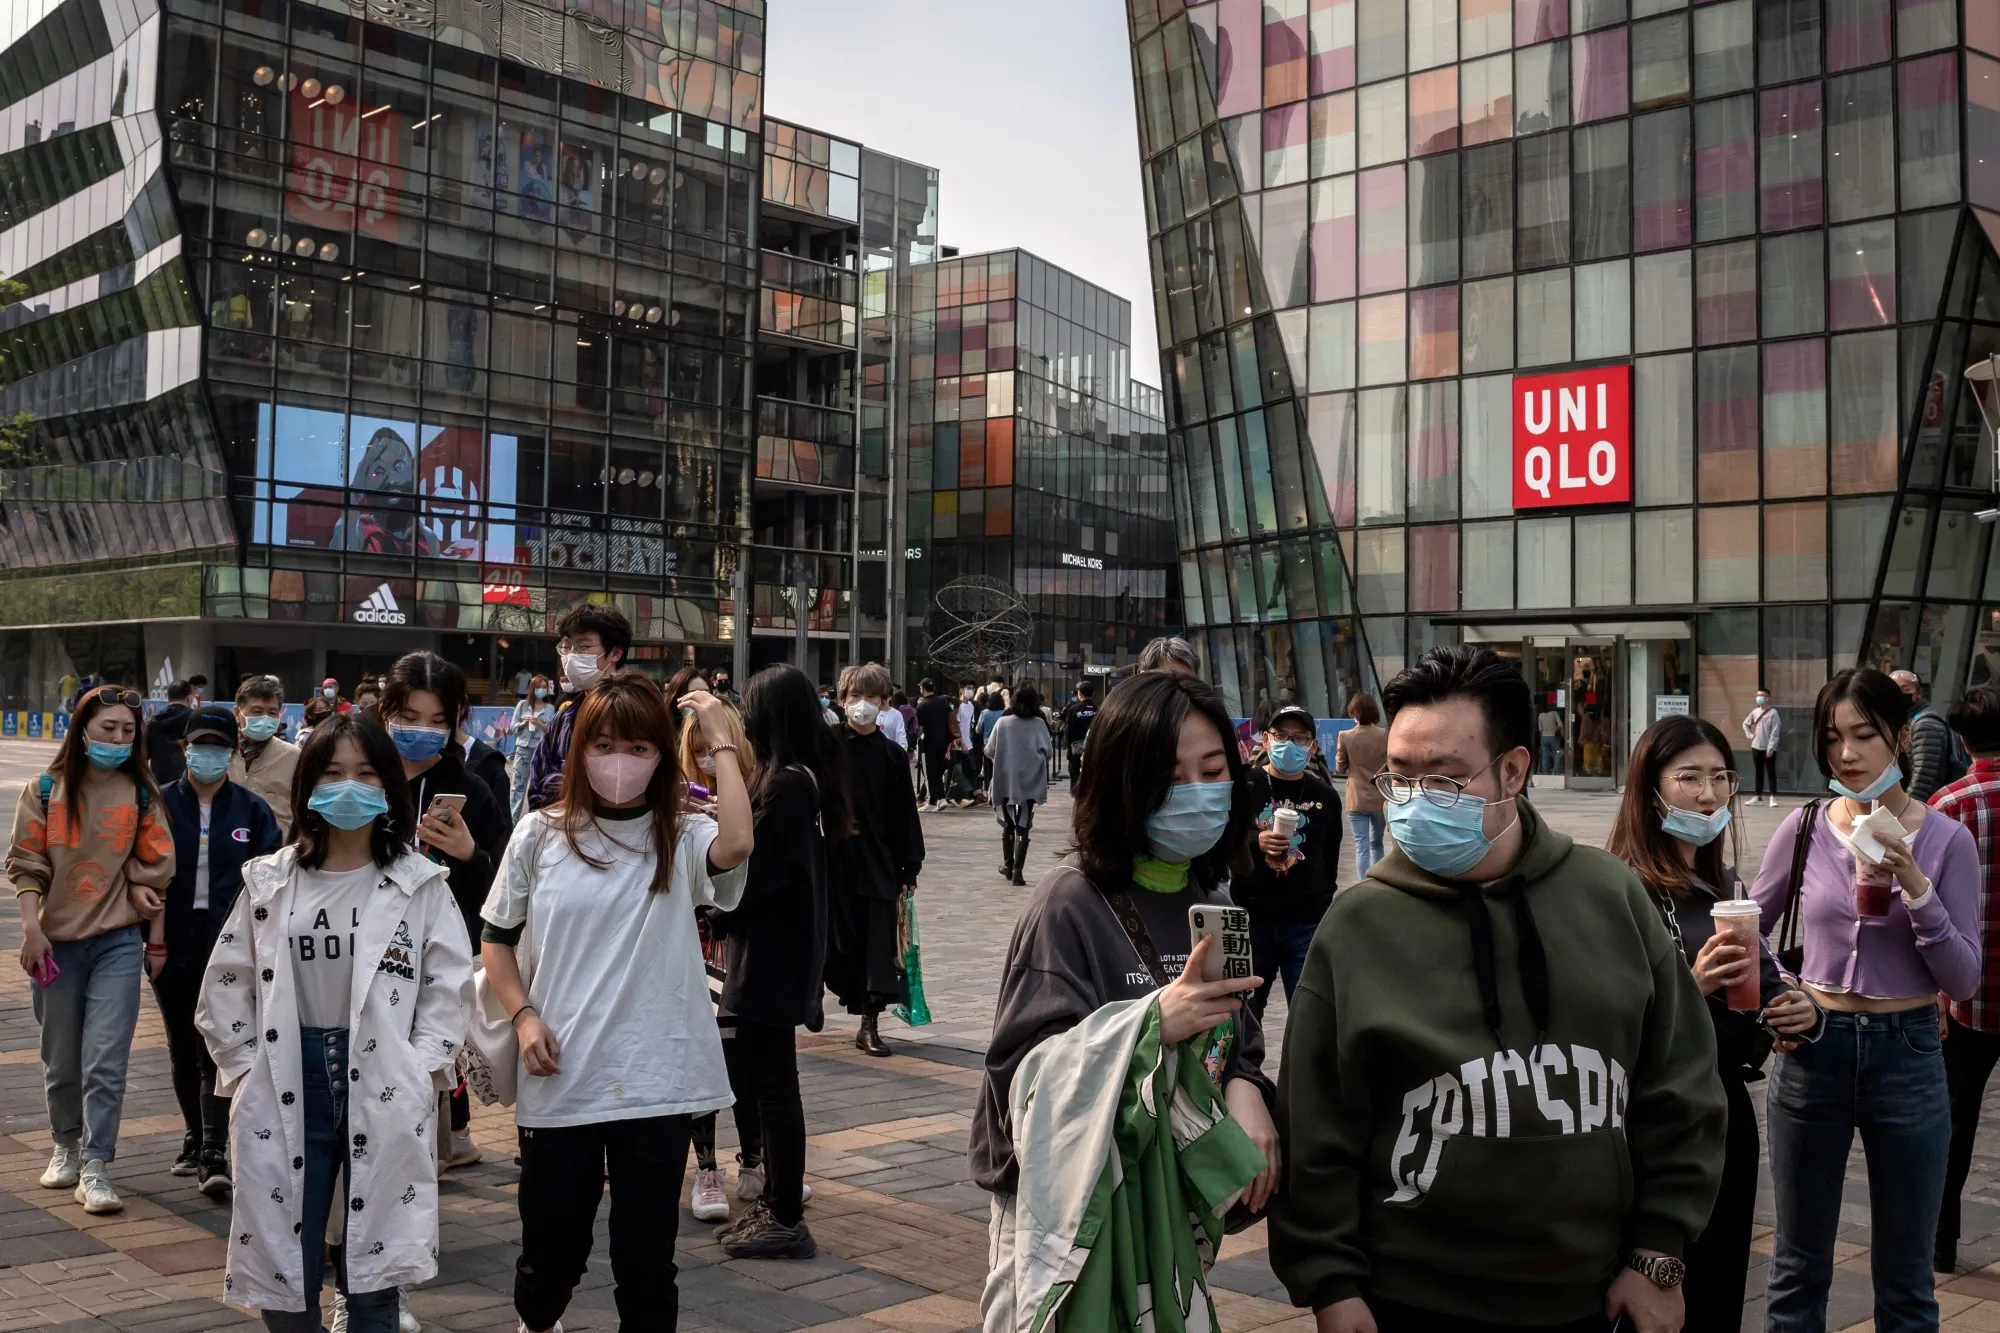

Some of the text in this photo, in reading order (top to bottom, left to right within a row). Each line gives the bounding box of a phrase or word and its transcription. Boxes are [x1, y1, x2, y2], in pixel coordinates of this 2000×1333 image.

[1524, 383, 1607, 435] UNI
[1524, 440, 1616, 499] QLO
[1062, 552, 1103, 570] MICHAEL KORS
[353, 608, 406, 625] adidas
[1163, 963, 1184, 974] EACE
[1220, 909, 1252, 1000] 運動個
